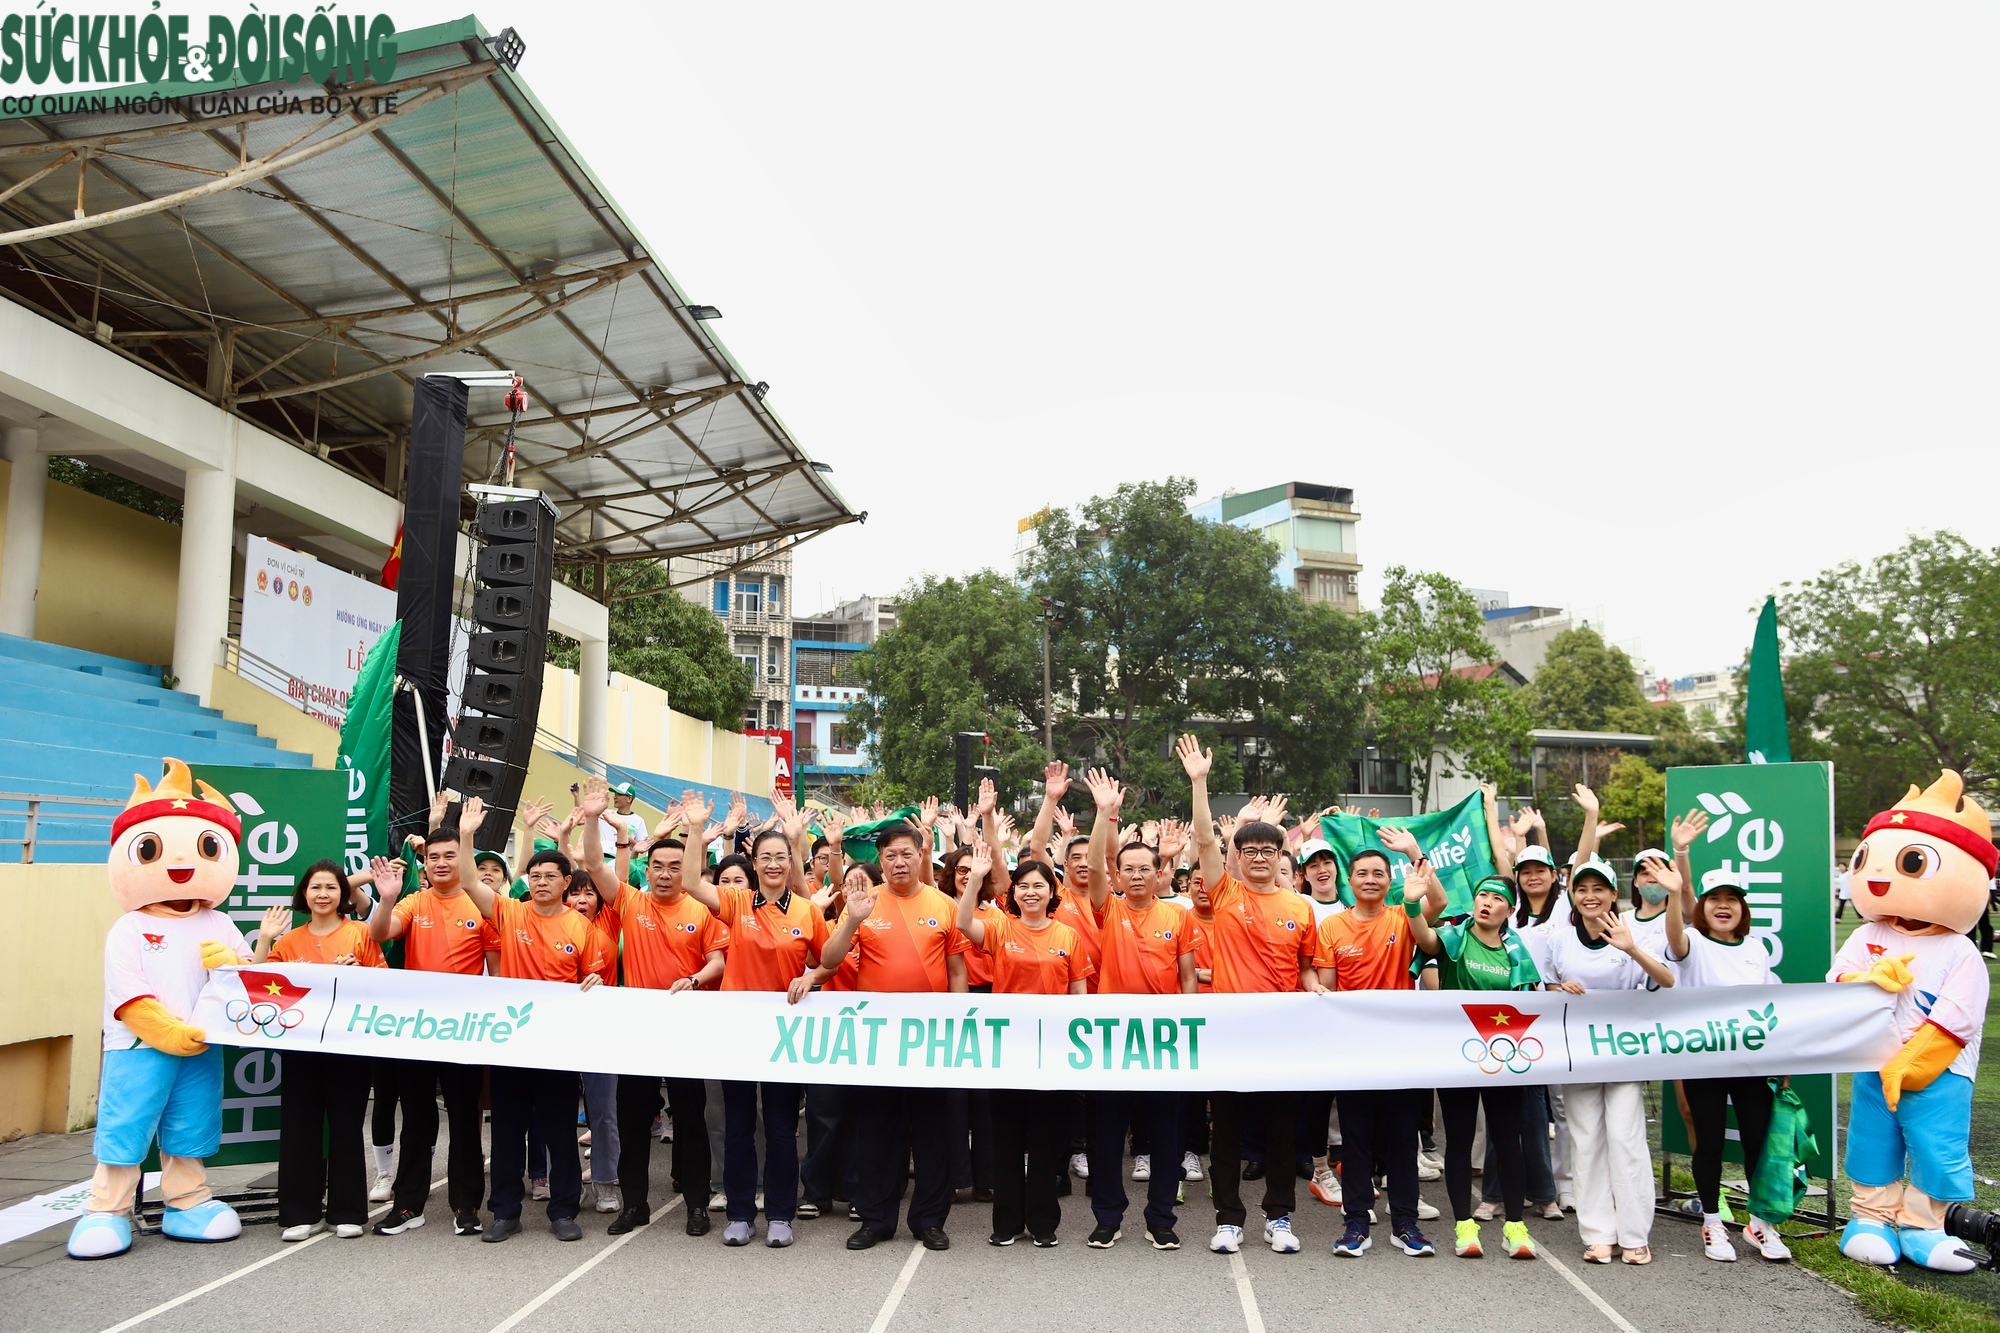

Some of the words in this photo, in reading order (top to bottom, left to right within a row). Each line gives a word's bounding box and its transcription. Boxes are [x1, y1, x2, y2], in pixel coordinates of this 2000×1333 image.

[267, 557, 280, 569] ĐƠN
[286, 564, 298, 575] CHỦ
[356, 613, 367, 630] ỨNG
[368, 620, 382, 634] NGÀY
[288, 675, 306, 700] GIẢ
[1465, 959, 1510, 977] Herbalife
[347, 1004, 513, 1044] Herbalife
[770, 1001, 887, 1065] XUẤT
[898, 1007, 1010, 1068] PHÁT
[1068, 1017, 1207, 1070] START
[1588, 1018, 1767, 1056] Herbalife
